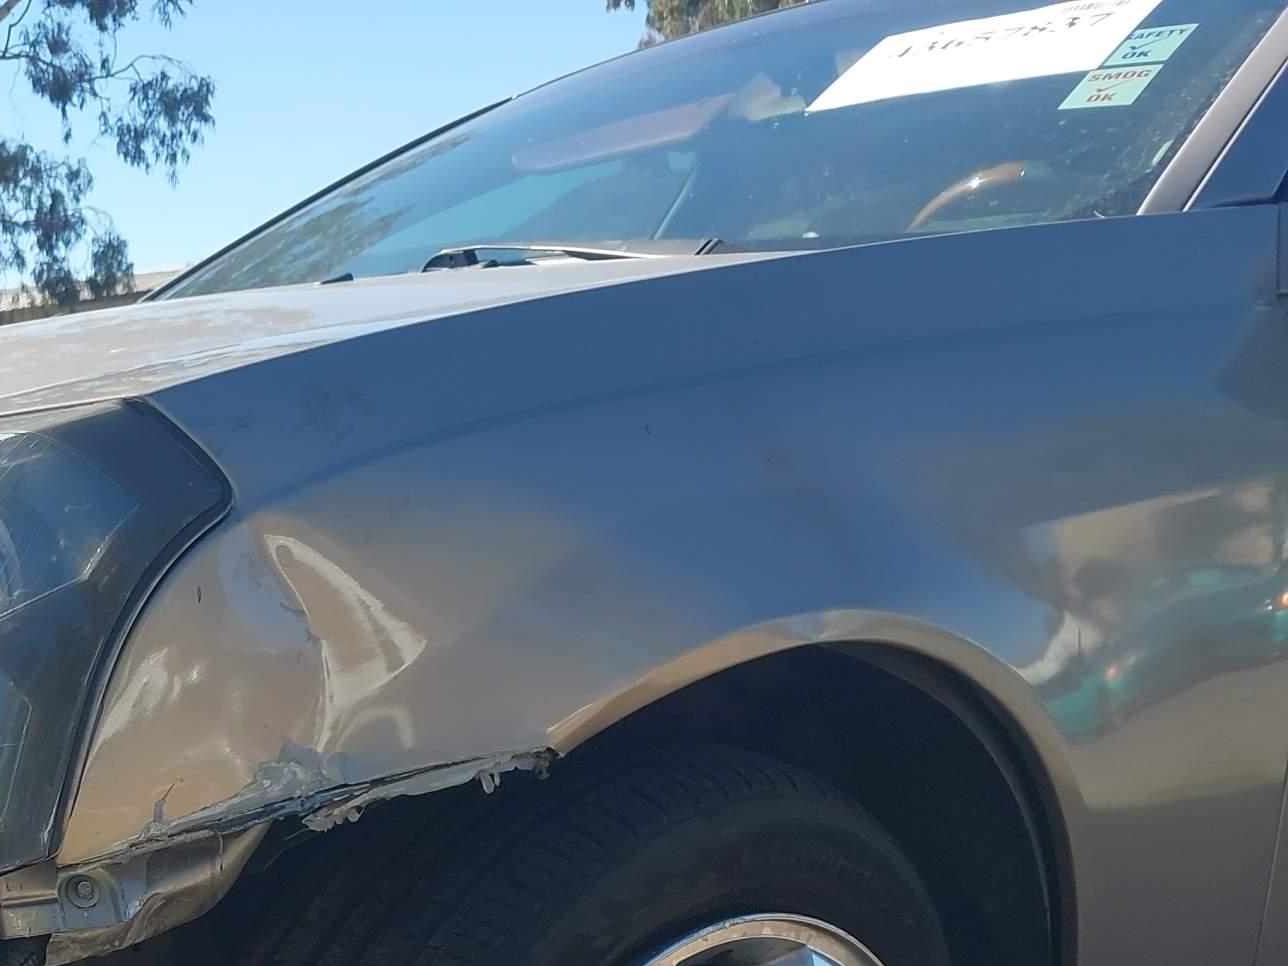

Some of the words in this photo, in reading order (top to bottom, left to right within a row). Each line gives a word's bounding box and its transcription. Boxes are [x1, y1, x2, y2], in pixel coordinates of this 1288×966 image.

[1121, 49, 1152, 59] OK
[1088, 69, 1152, 82] SMOG
[1086, 92, 1117, 103] OK
